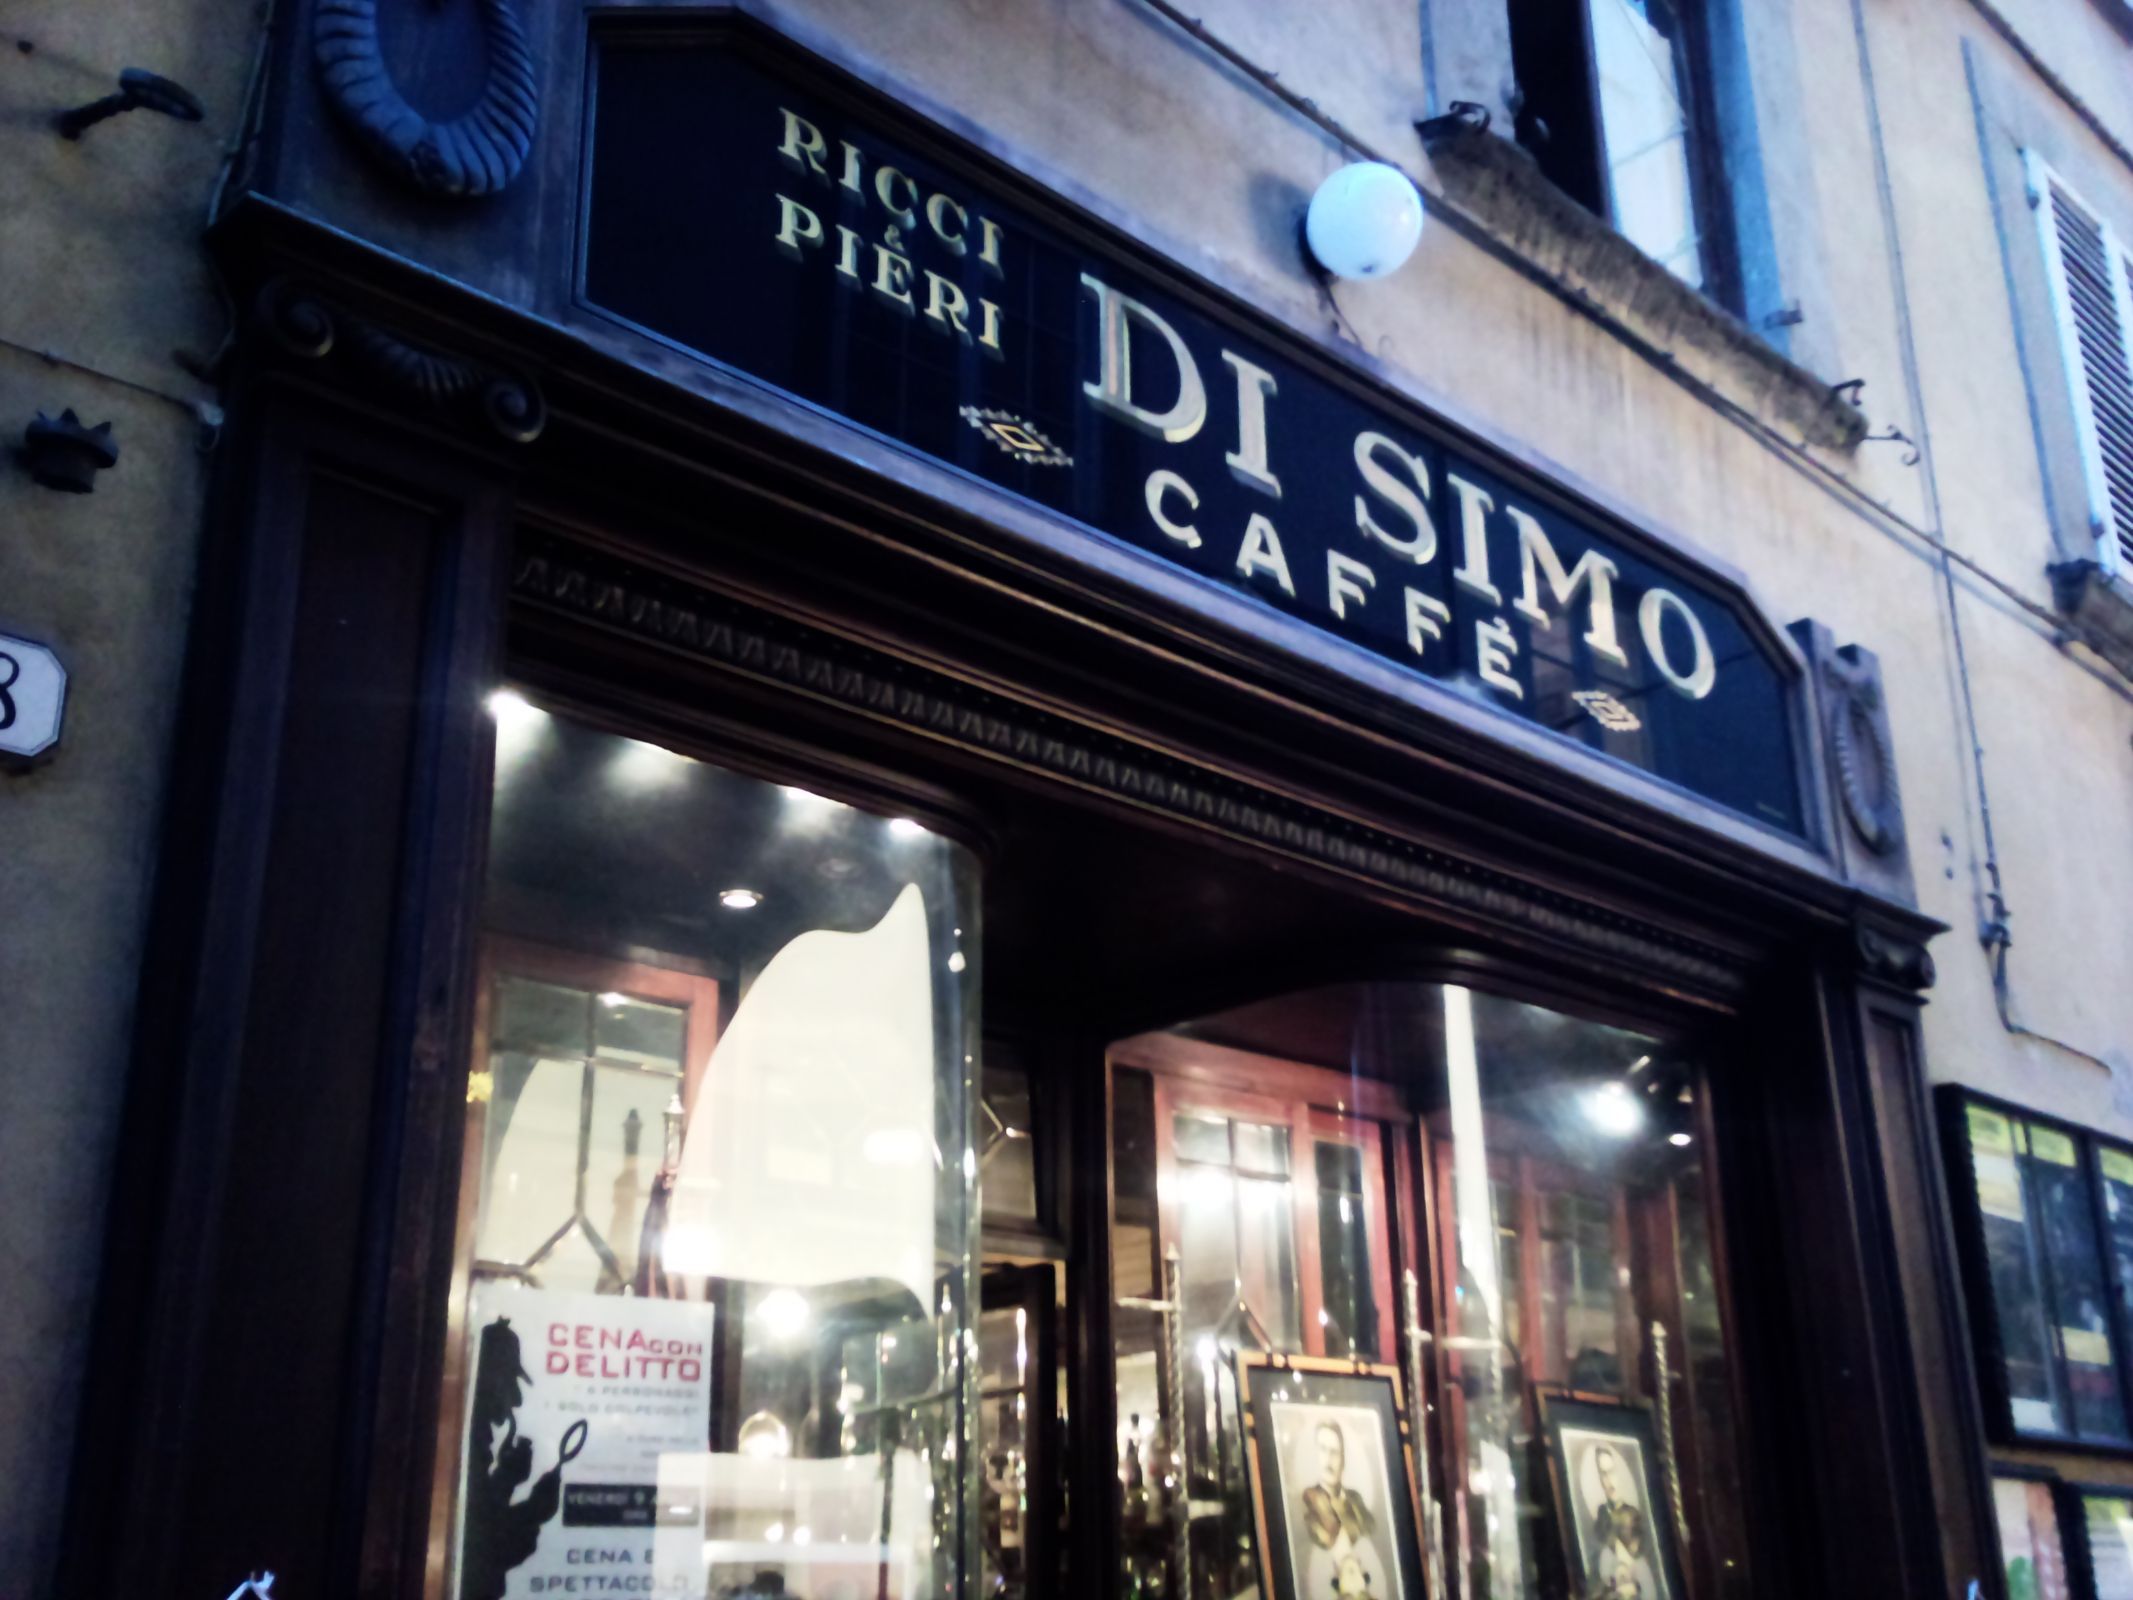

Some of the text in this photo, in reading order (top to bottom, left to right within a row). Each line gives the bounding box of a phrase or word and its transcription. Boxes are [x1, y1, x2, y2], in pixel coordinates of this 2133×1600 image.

[778, 107, 1004, 274] RICCI
[884, 224, 905, 252] &
[775, 193, 1004, 352] PIERI
[1081, 272, 1717, 699] DI SIMO
[548, 1323, 648, 1351] CENA
[547, 1351, 701, 1381] DELITTO
[566, 1548, 632, 1564] CENA
